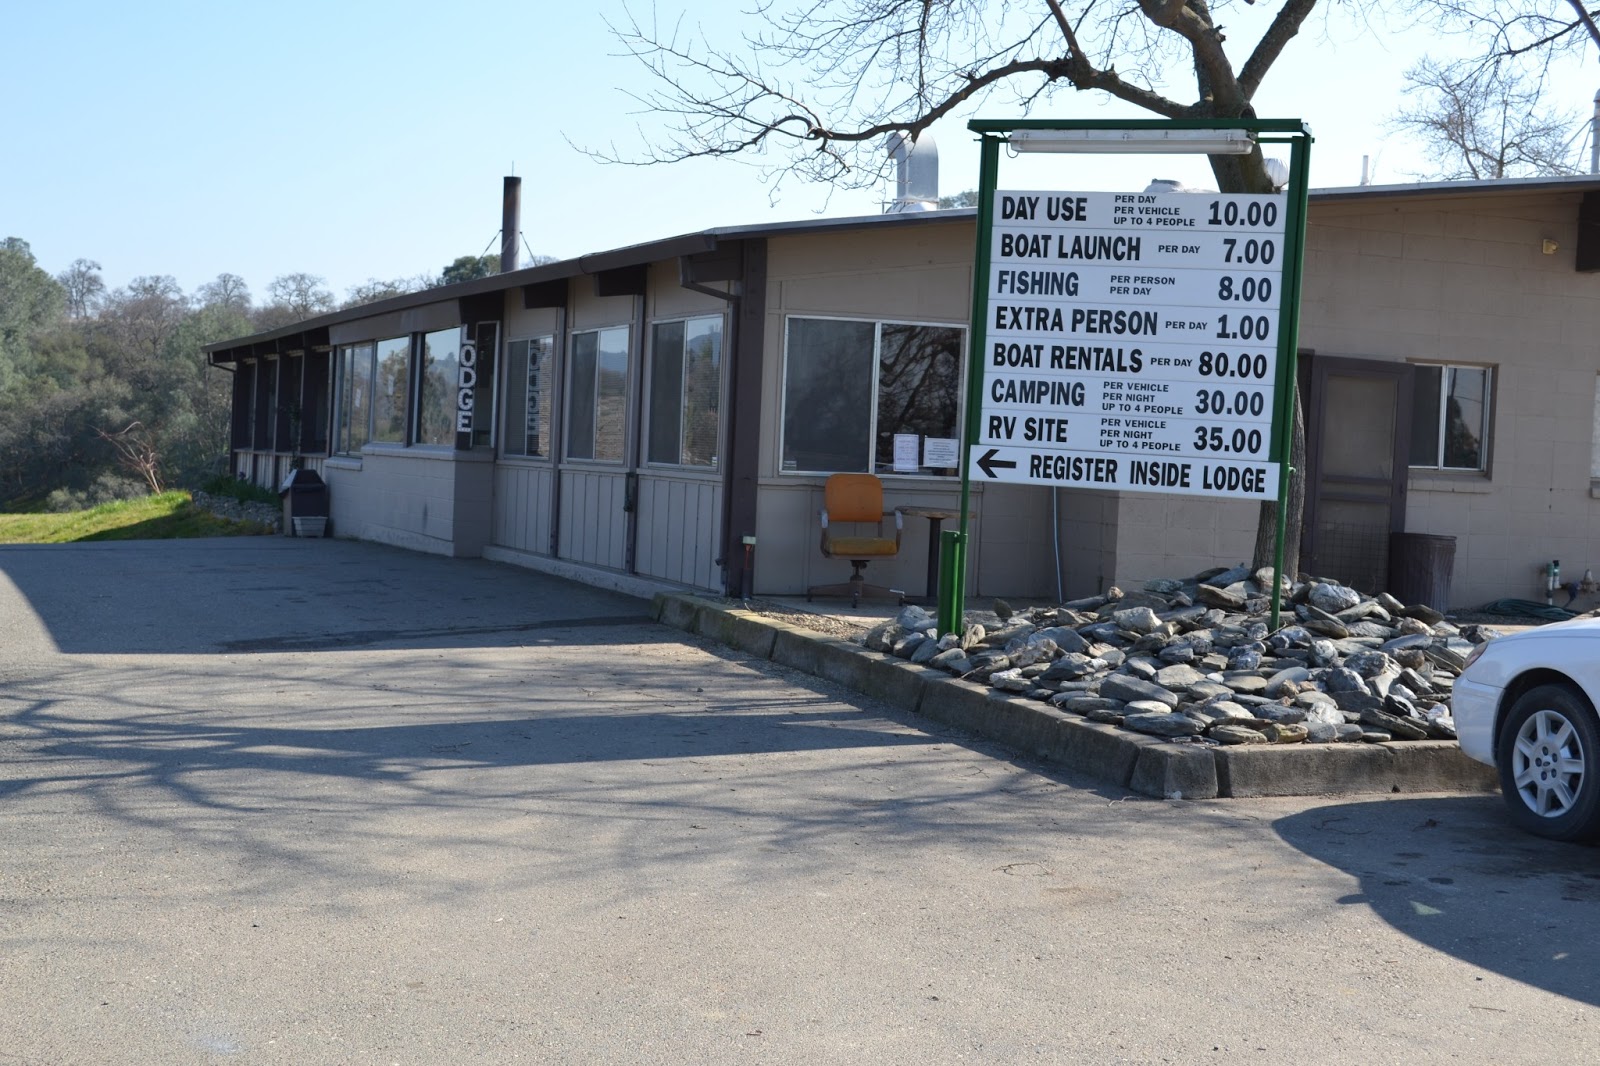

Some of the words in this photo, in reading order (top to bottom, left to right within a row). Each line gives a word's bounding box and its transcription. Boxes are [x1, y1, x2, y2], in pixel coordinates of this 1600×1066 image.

[1002, 197, 1039, 220] DAY
[1047, 197, 1087, 221] USE
[1114, 195, 1135, 204] PER
[1137, 196, 1157, 204] DAY
[1114, 207, 1135, 215] PER
[1137, 207, 1180, 216] VEHICLE
[1113, 217, 1127, 225] UP
[1129, 217, 1144, 226] TO
[1146, 217, 1153, 226] 4
[1155, 218, 1196, 227] PEOPLE
[1208, 201, 1277, 226] 10.00
[1001, 234, 1051, 258] BOAT
[1058, 235, 1140, 261] LAUNCH
[1158, 245, 1179, 254] PER
[1181, 246, 1201, 254] DAY
[1224, 239, 1274, 264] 7.00
[998, 271, 1078, 296] FISHING
[1109, 287, 1130, 295] PER
[1132, 288, 1152, 296] DAY
[1110, 275, 1131, 284] PER
[1133, 276, 1176, 286] PERSON
[1219, 276, 1271, 302] 8.00
[996, 306, 1063, 331] EXTRA
[1072, 309, 1157, 335] PERSON
[1165, 321, 1186, 330] PER
[1188, 322, 1208, 330] DAY
[1217, 315, 1269, 340] 1.00
[994, 343, 1044, 368] BOAT
[1051, 346, 1142, 373] RENTALS
[1150, 358, 1171, 366] PER
[1173, 359, 1193, 367] DAY
[1199, 352, 1267, 379] 80.00
[457, 324, 476, 432] LODGE
[1103, 382, 1124, 390] PER
[1126, 383, 1169, 393] VEHICLE
[992, 379, 1085, 406] CAMPING
[1102, 393, 1123, 401] PER
[1125, 394, 1156, 403] NIGHT
[1195, 390, 1263, 416] 30.00
[1101, 403, 1116, 411] UP
[1118, 404, 1132, 412] TO
[1134, 404, 1141, 413] 4
[1143, 405, 1184, 415] PEOPLE
[989, 416, 1016, 439] RV
[1024, 417, 1068, 442] SITE
[1100, 418, 1121, 427] PER
[1124, 420, 1167, 429] VEHICLE
[1100, 430, 1121, 438] PER
[1123, 431, 1153, 440] NIGHT
[1099, 440, 1114, 448] UP
[1116, 440, 1129, 449] TO
[1132, 440, 1139, 449] 4
[1141, 442, 1181, 452] PEOPLE
[1193, 426, 1261, 454] 35.00
[1030, 455, 1117, 483] REGISTER
[1130, 461, 1191, 487] INSIDE
[1203, 466, 1266, 493] LODGE
